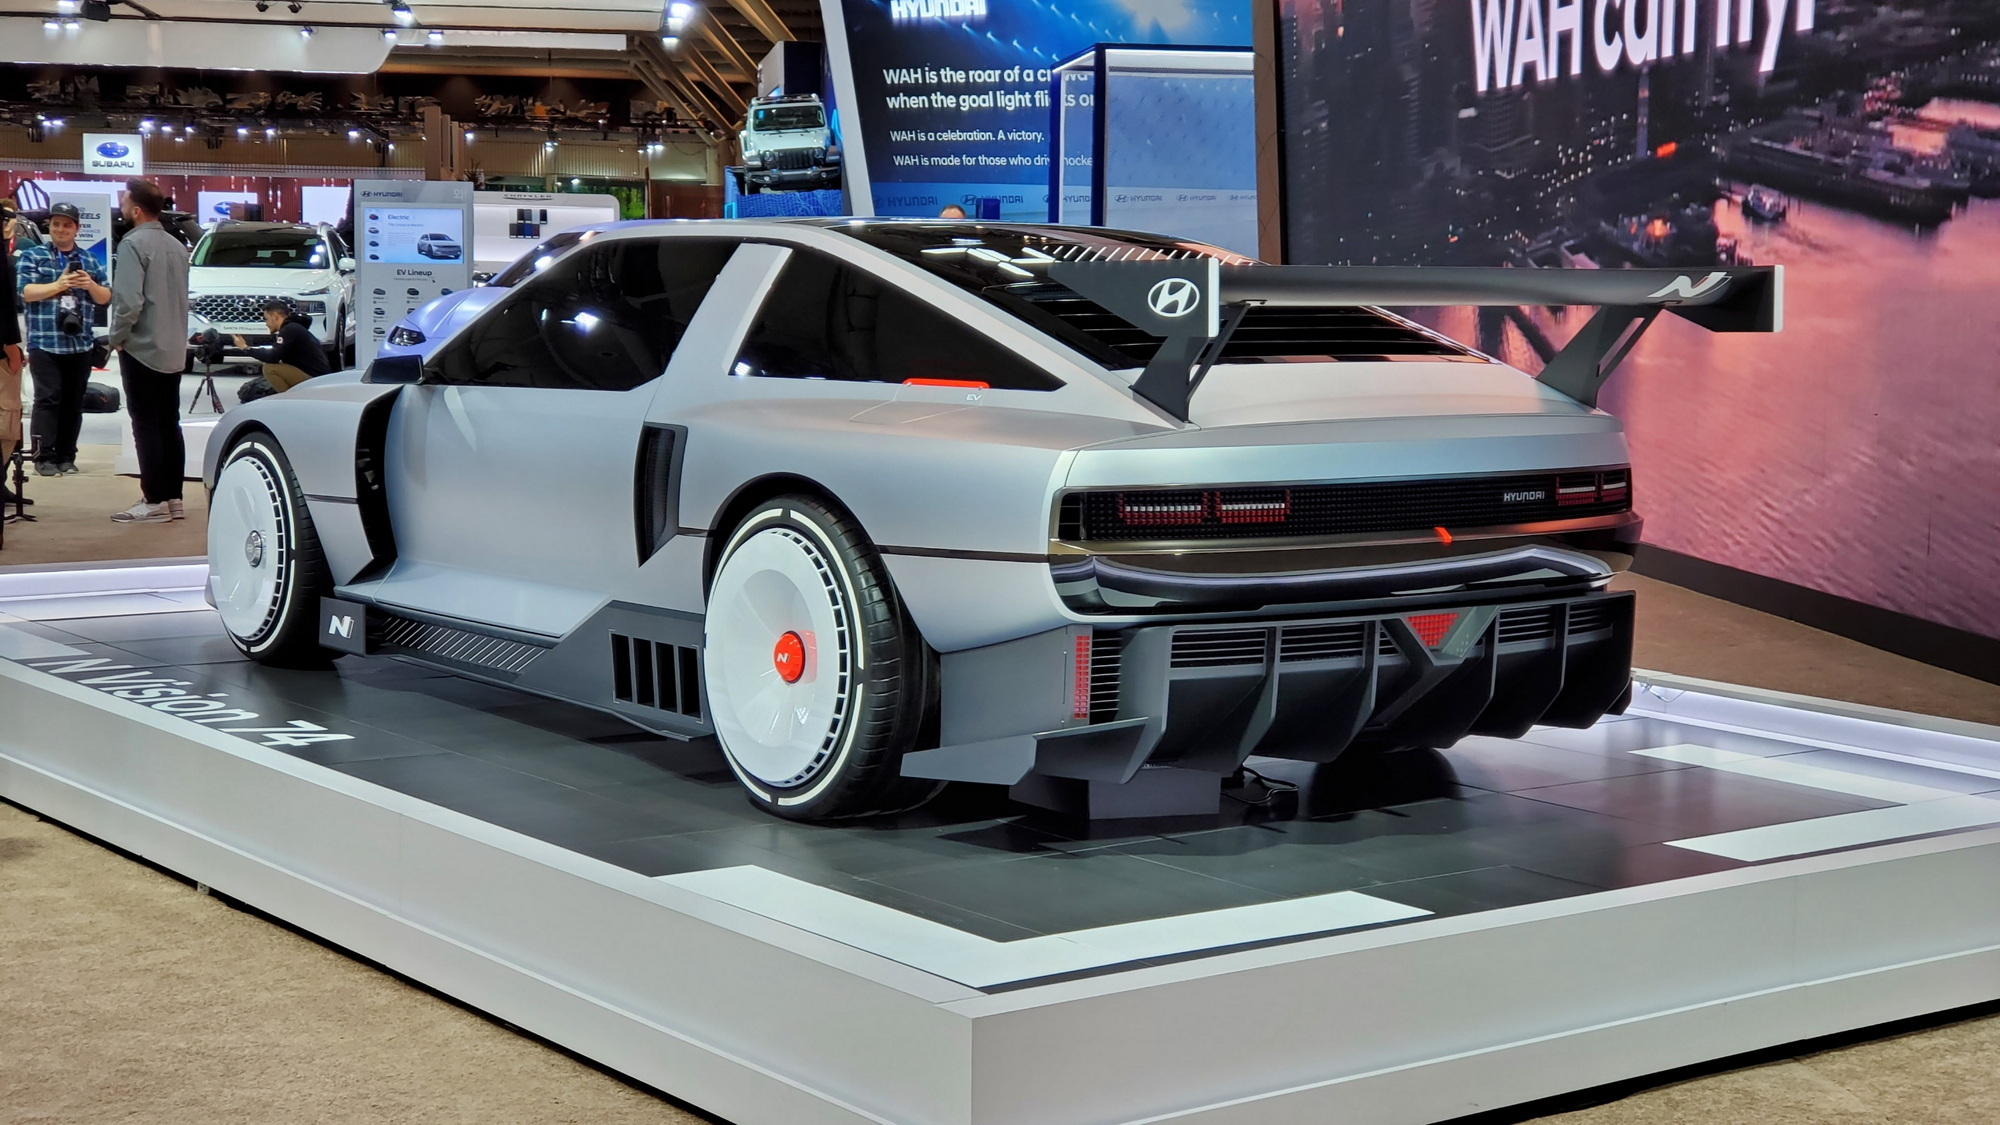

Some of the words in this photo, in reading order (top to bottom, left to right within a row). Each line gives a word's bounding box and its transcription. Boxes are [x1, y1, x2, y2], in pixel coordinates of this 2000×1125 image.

[890, 0, 986, 19] HYUNDAI
[1471, 0, 1582, 92] WAH
[1594, 0, 1696, 70] can
[883, 68, 922, 84] WAH
[925, 67, 938, 83] is
[940, 67, 966, 82] the
[969, 69, 1001, 82] roar
[1003, 66, 1020, 82] of
[1023, 69, 1034, 82] a
[886, 93, 929, 108] when
[930, 92, 957, 108] the
[959, 91, 994, 111] goal
[996, 90, 1032, 111] light
[890, 130, 916, 141] WAH
[917, 130, 926, 141] is
[927, 132, 935, 141] a
[936, 129, 996, 141] celebration.
[997, 130, 1006, 141] A
[1007, 129, 1045, 143] victory.
[92, 160, 135, 168] SUBARU
[893, 155, 919, 166] WAH
[920, 155, 930, 166] is
[930, 155, 961, 166] made
[962, 154, 977, 166] for
[978, 154, 1007, 166] those
[1008, 154, 1032, 166] who
[887, 196, 938, 207] HYUNDAI
[407, 269, 432, 277] Lineup
[966, 393, 982, 401] EV
[1503, 490, 1546, 502] HYUNDAI
[76, 671, 261, 724] Vision
[217, 719, 357, 747] 74
